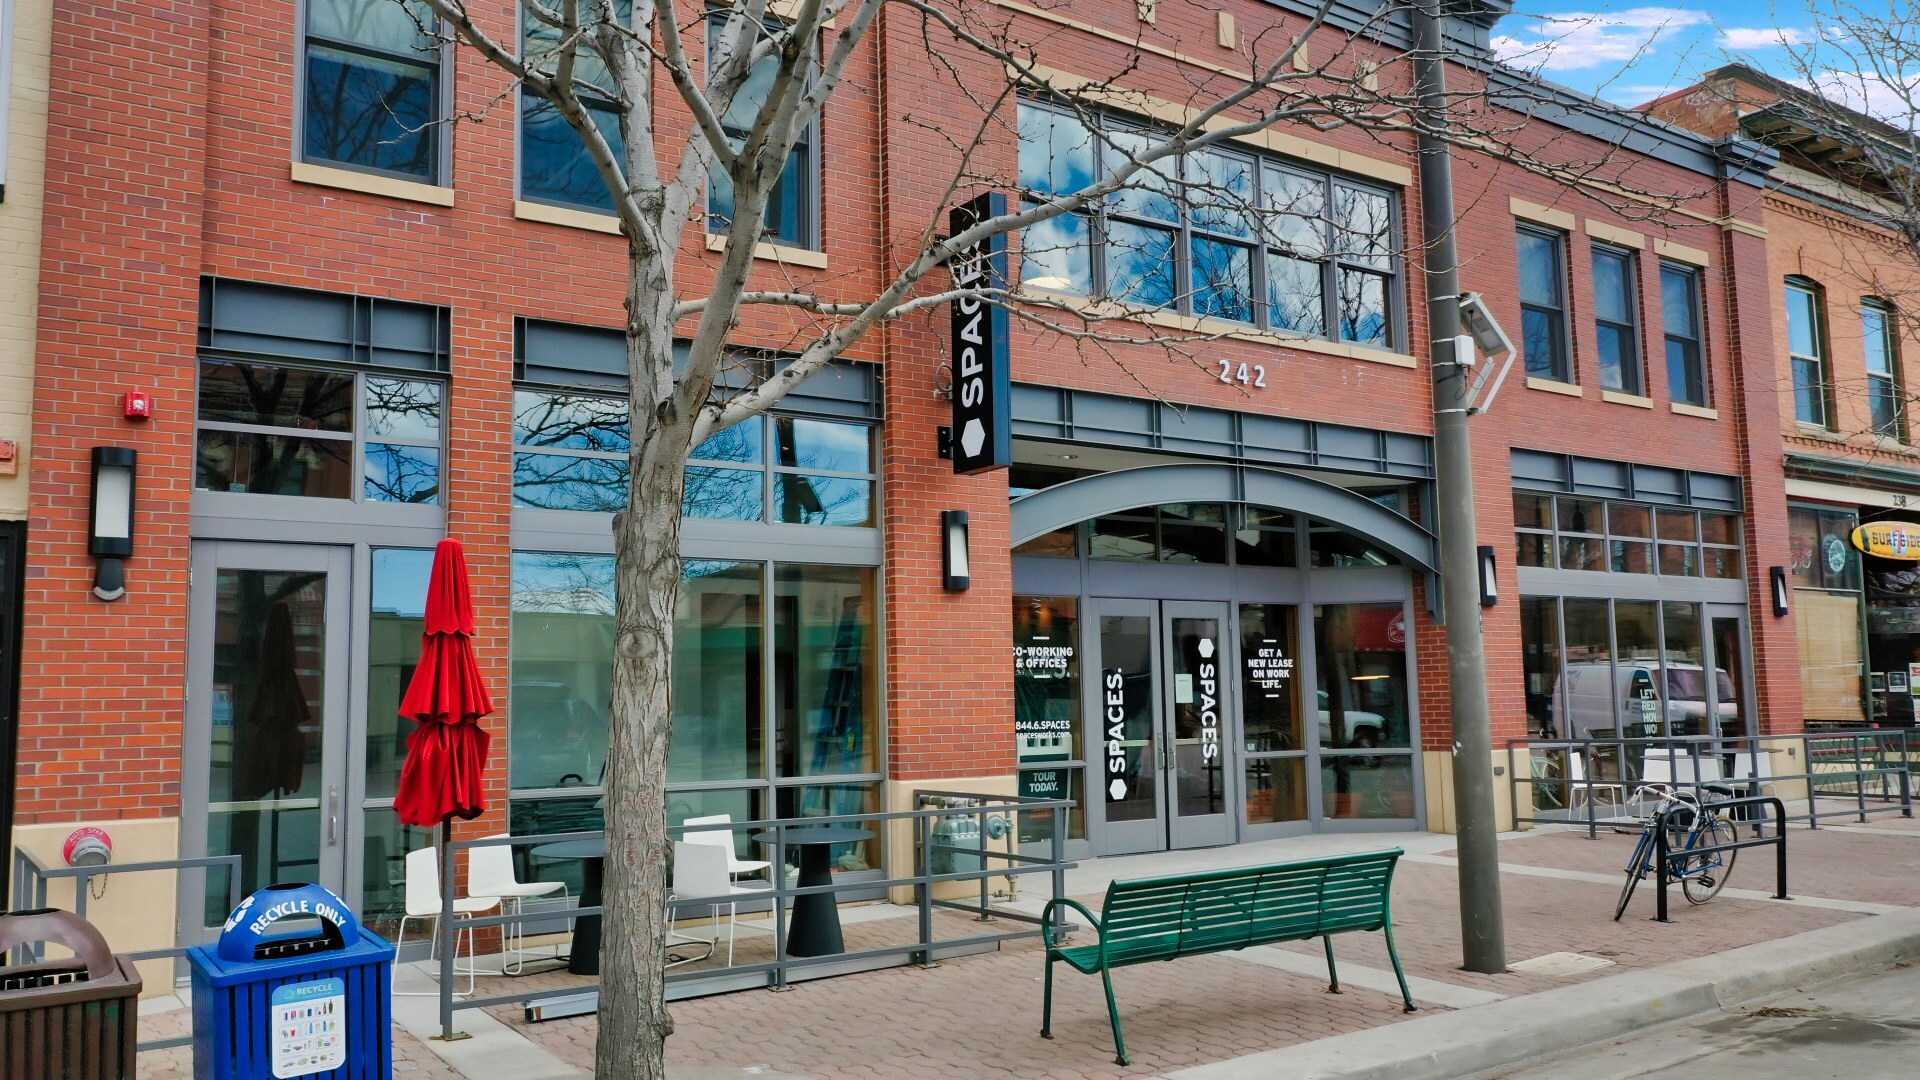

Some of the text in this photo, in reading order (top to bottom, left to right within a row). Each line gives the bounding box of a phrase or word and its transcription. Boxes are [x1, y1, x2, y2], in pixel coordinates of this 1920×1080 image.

[1219, 359, 1266, 388] 242
[1893, 494, 1907, 507] 238
[1258, 649, 1282, 657] GET A
[1016, 658, 1067, 668] & OFFICES
[1248, 659, 1293, 668] NEW LEASE
[1253, 670, 1290, 678] ON WORK
[1262, 680, 1282, 688] LIFE.
[1199, 664, 1218, 764] SPACES.
[1107, 667, 1126, 773] SPACES.
[1033, 772, 1056, 781] TOUR
[1029, 782, 1058, 792] TODAY.
[249, 900, 347, 936] RECYCLE ONLY
[296, 984, 333, 995] RECYCLE
